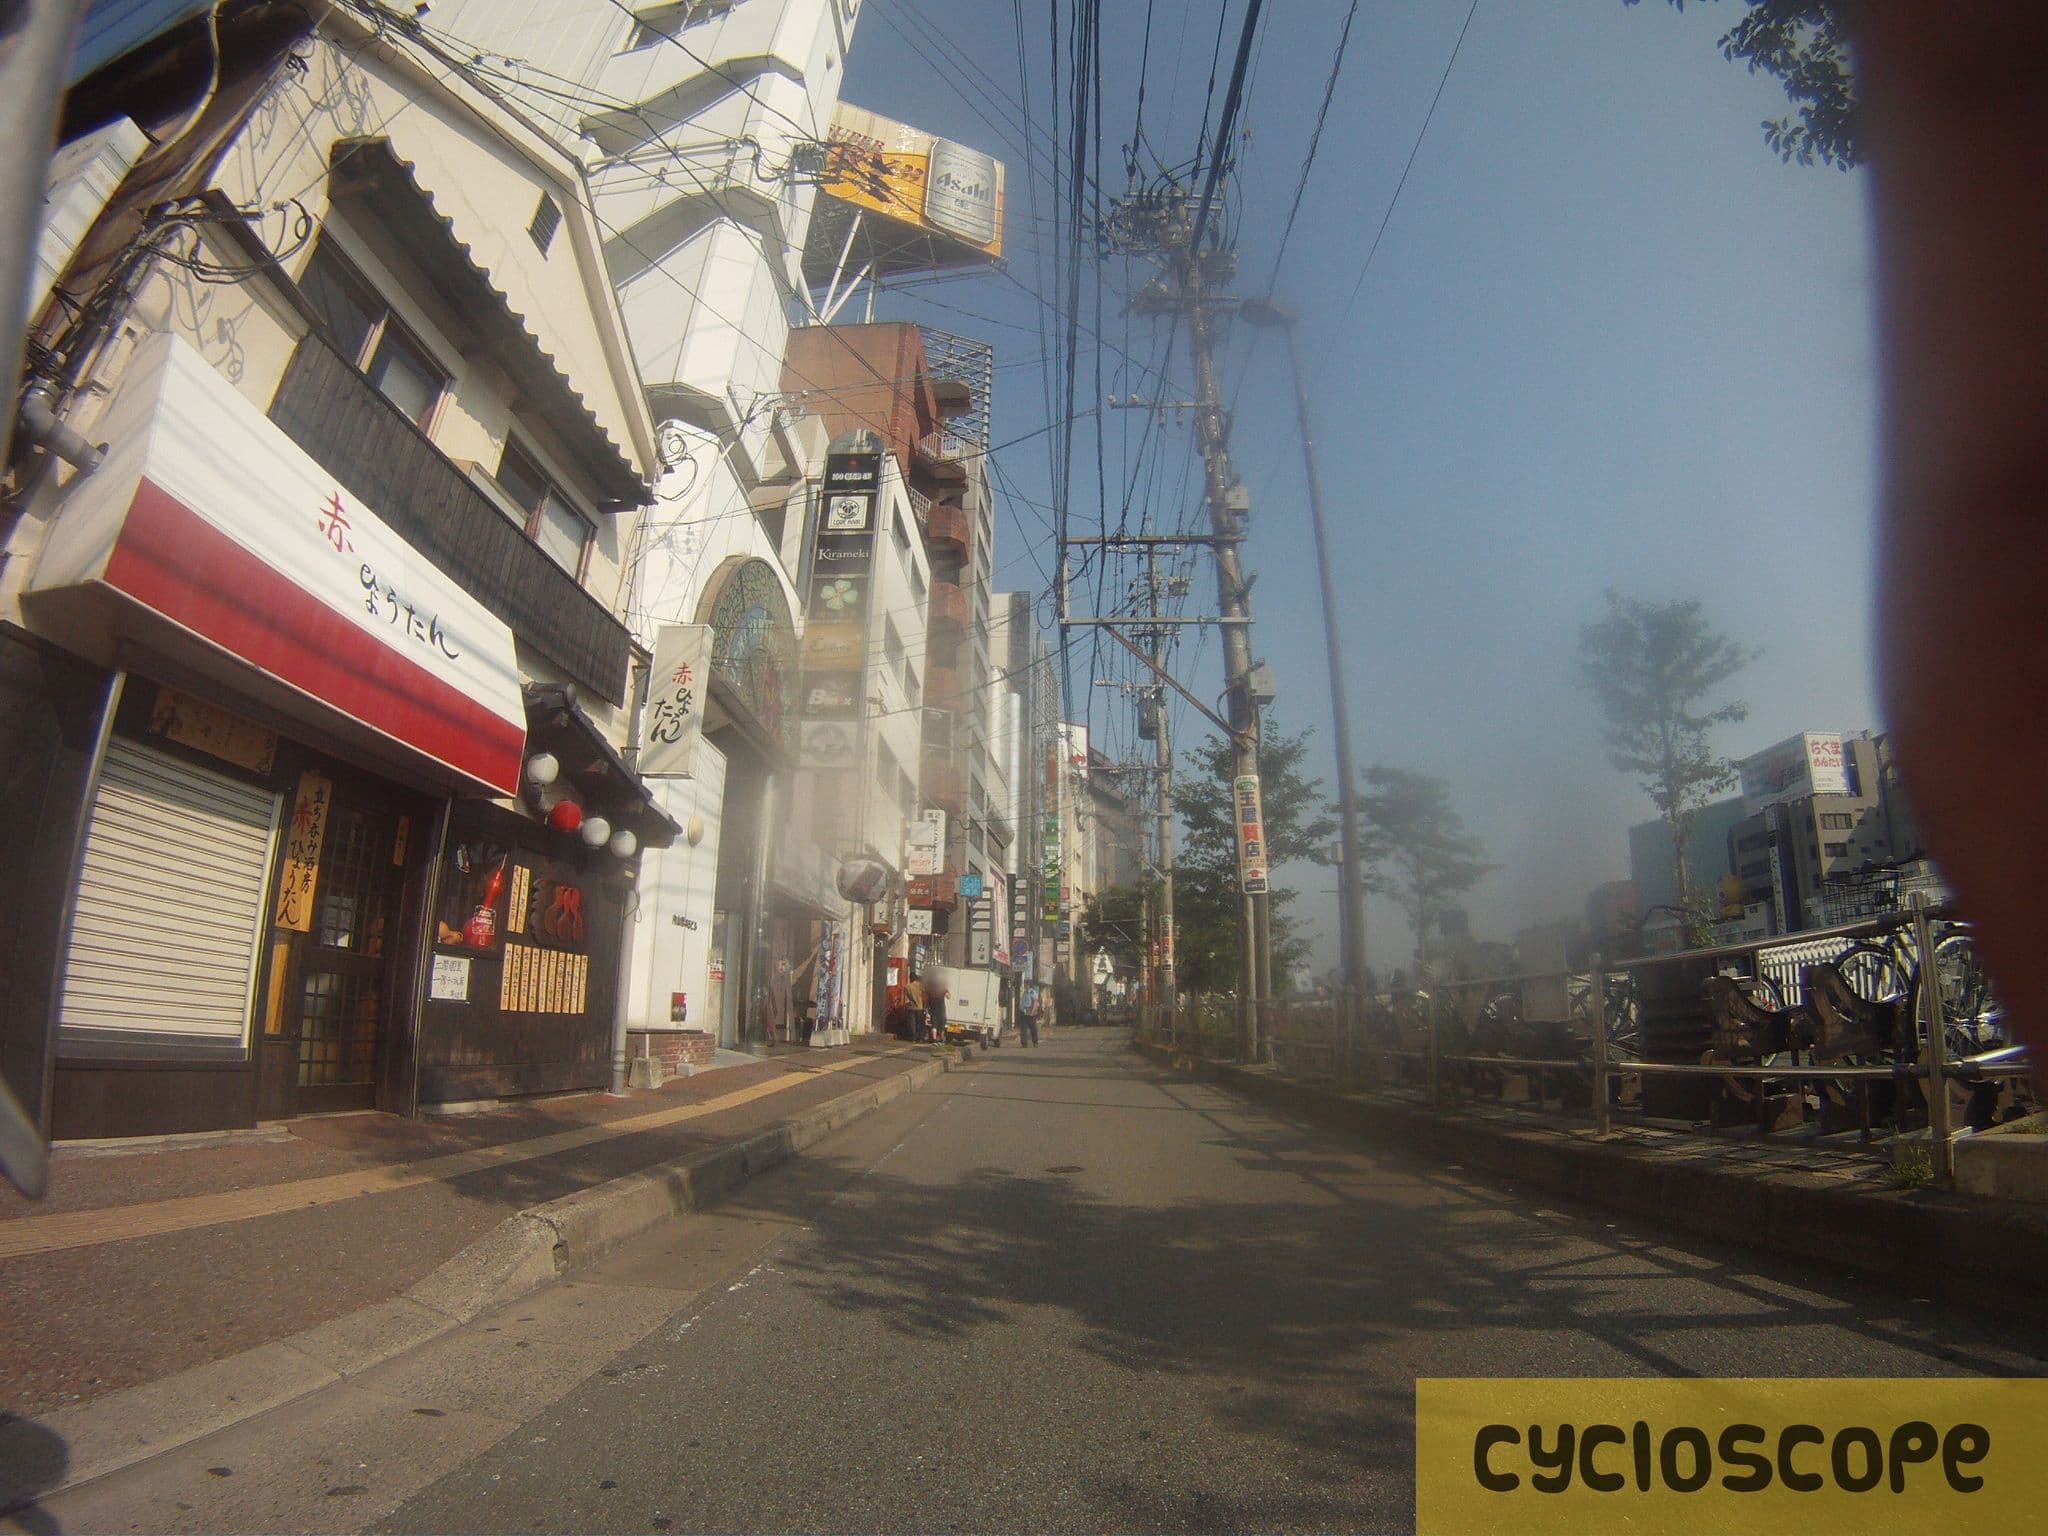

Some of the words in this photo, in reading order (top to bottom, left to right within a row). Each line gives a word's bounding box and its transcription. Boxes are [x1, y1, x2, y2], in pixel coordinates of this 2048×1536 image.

[318, 490, 355, 553] 赤
[359, 563, 460, 661] ひょうたん
[818, 547, 869, 561] Kirameki
